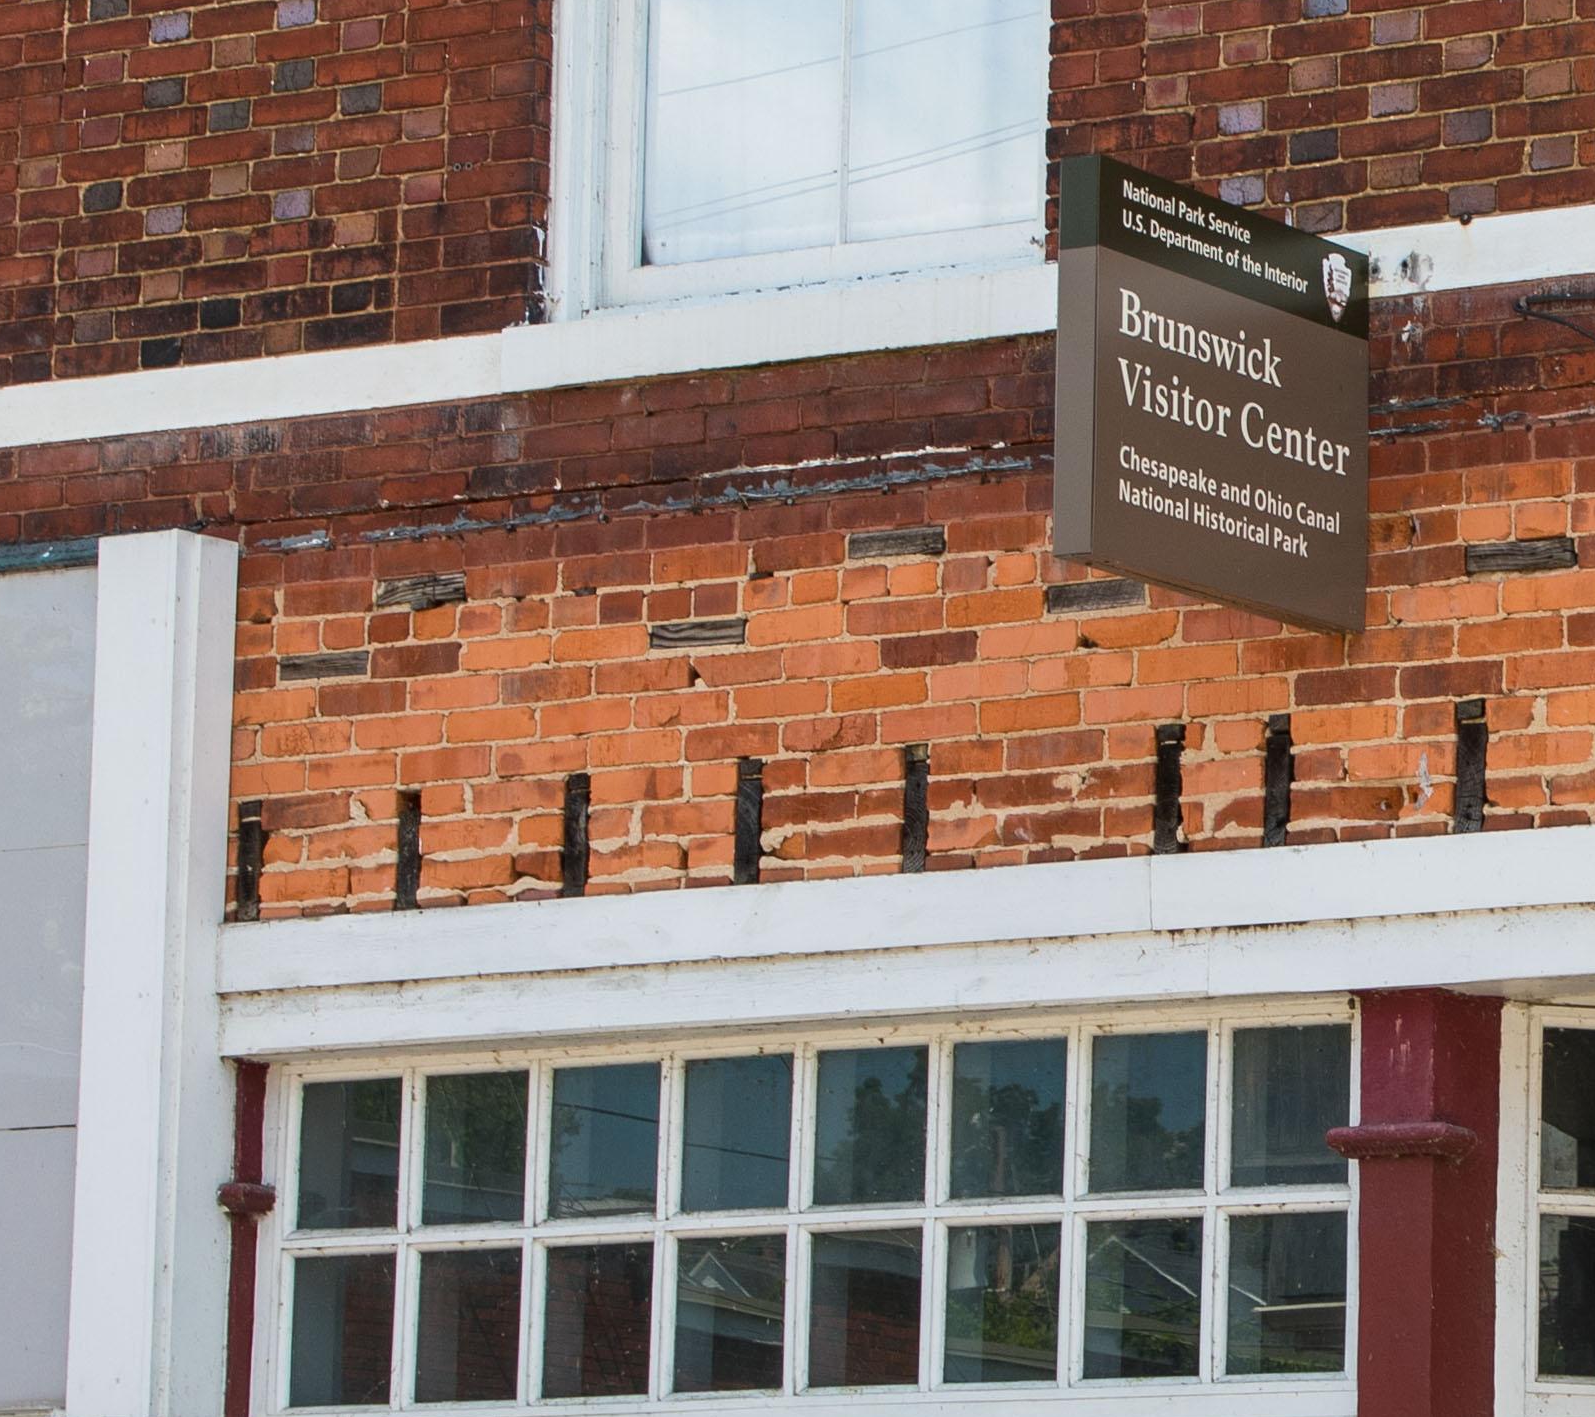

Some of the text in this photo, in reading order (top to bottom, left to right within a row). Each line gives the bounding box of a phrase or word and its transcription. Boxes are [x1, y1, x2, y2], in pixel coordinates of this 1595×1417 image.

[1122, 209, 1147, 235] U.S.
[1150, 219, 1223, 263] Department
[1226, 247, 1240, 269] of
[1242, 253, 1262, 278] the
[1264, 262, 1309, 294] Interior
[1123, 179, 1251, 245] National Park Service
[1119, 287, 1282, 388] Brunswick
[1118, 357, 1350, 476] Visitor Center
[1119, 445, 1340, 535] Chesapeake and Ohio Canal
[1119, 478, 1308, 558] National Historical Park
